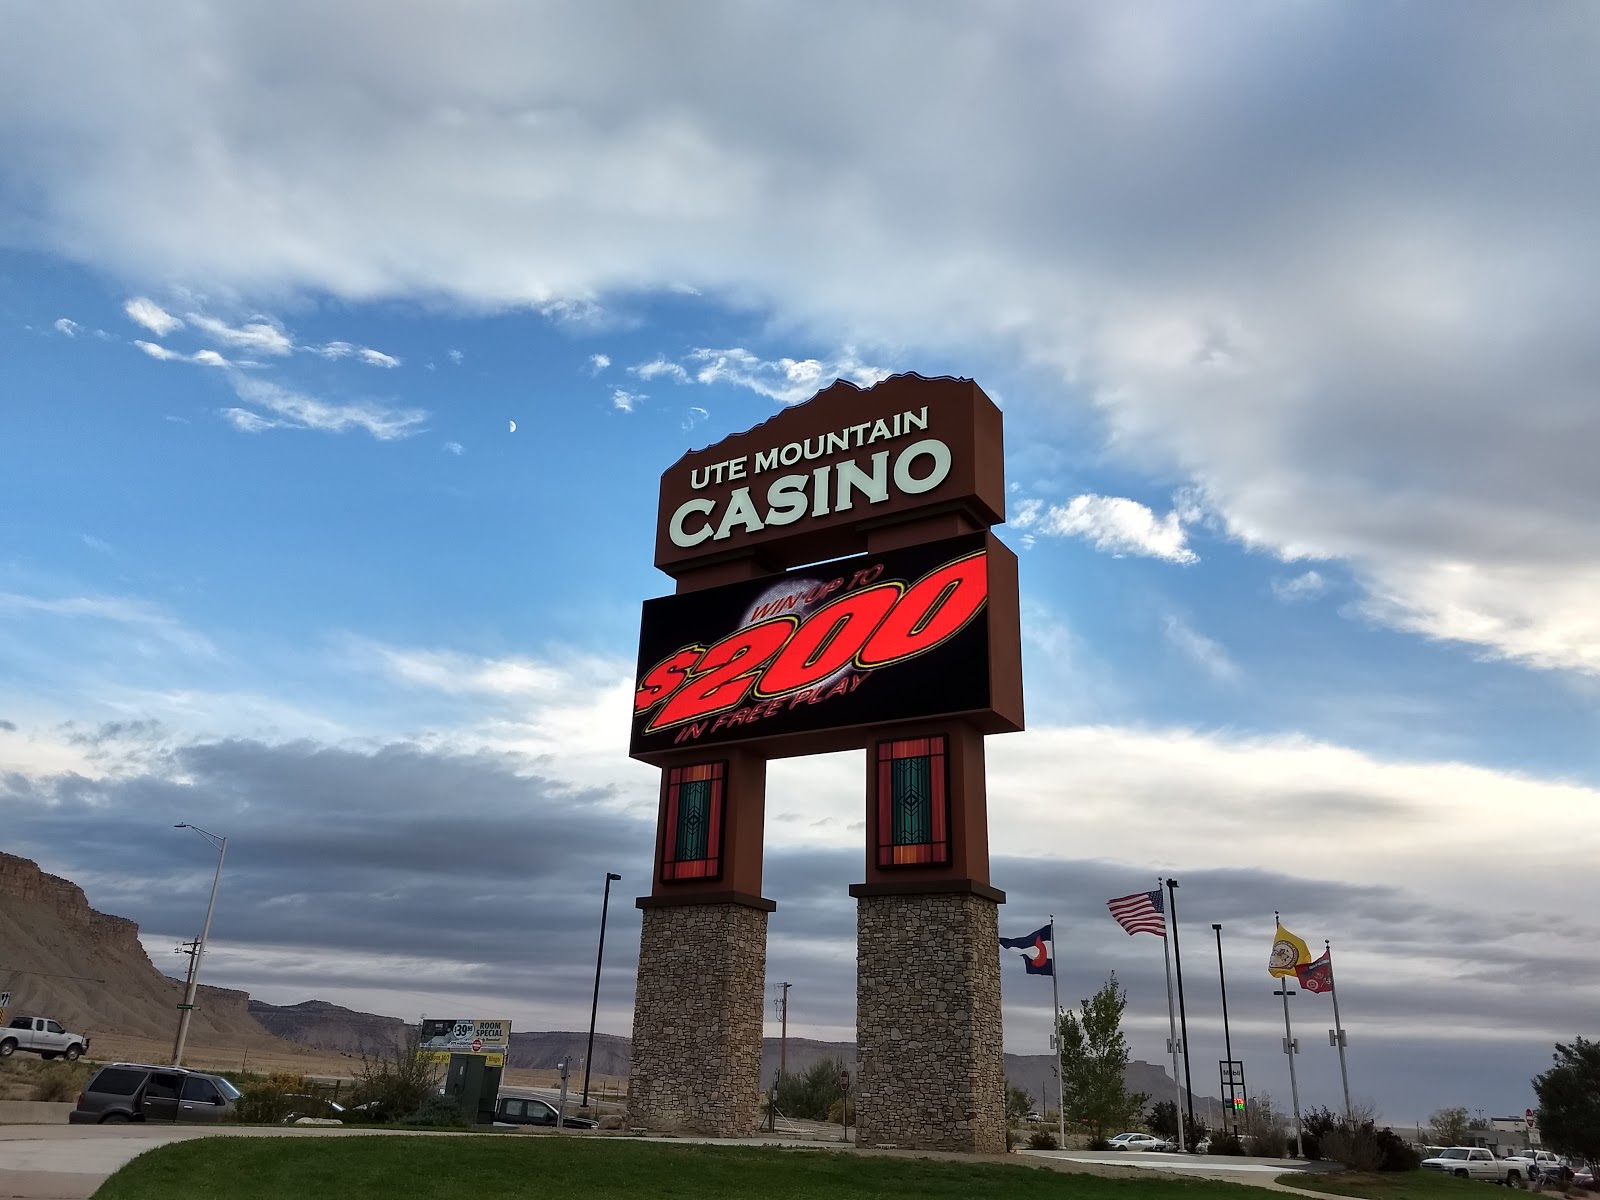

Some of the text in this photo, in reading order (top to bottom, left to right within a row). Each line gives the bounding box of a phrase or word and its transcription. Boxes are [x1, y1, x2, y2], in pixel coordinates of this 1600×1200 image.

[691, 406, 929, 490] UTE MOUNTAIN
[668, 439, 952, 548] CASINO
[750, 564, 884, 622] WIN UP TO
[635, 550, 988, 735] $200
[674, 671, 873, 744] IN FREE PLAY
[476, 1029, 503, 1037] SPECIAL
